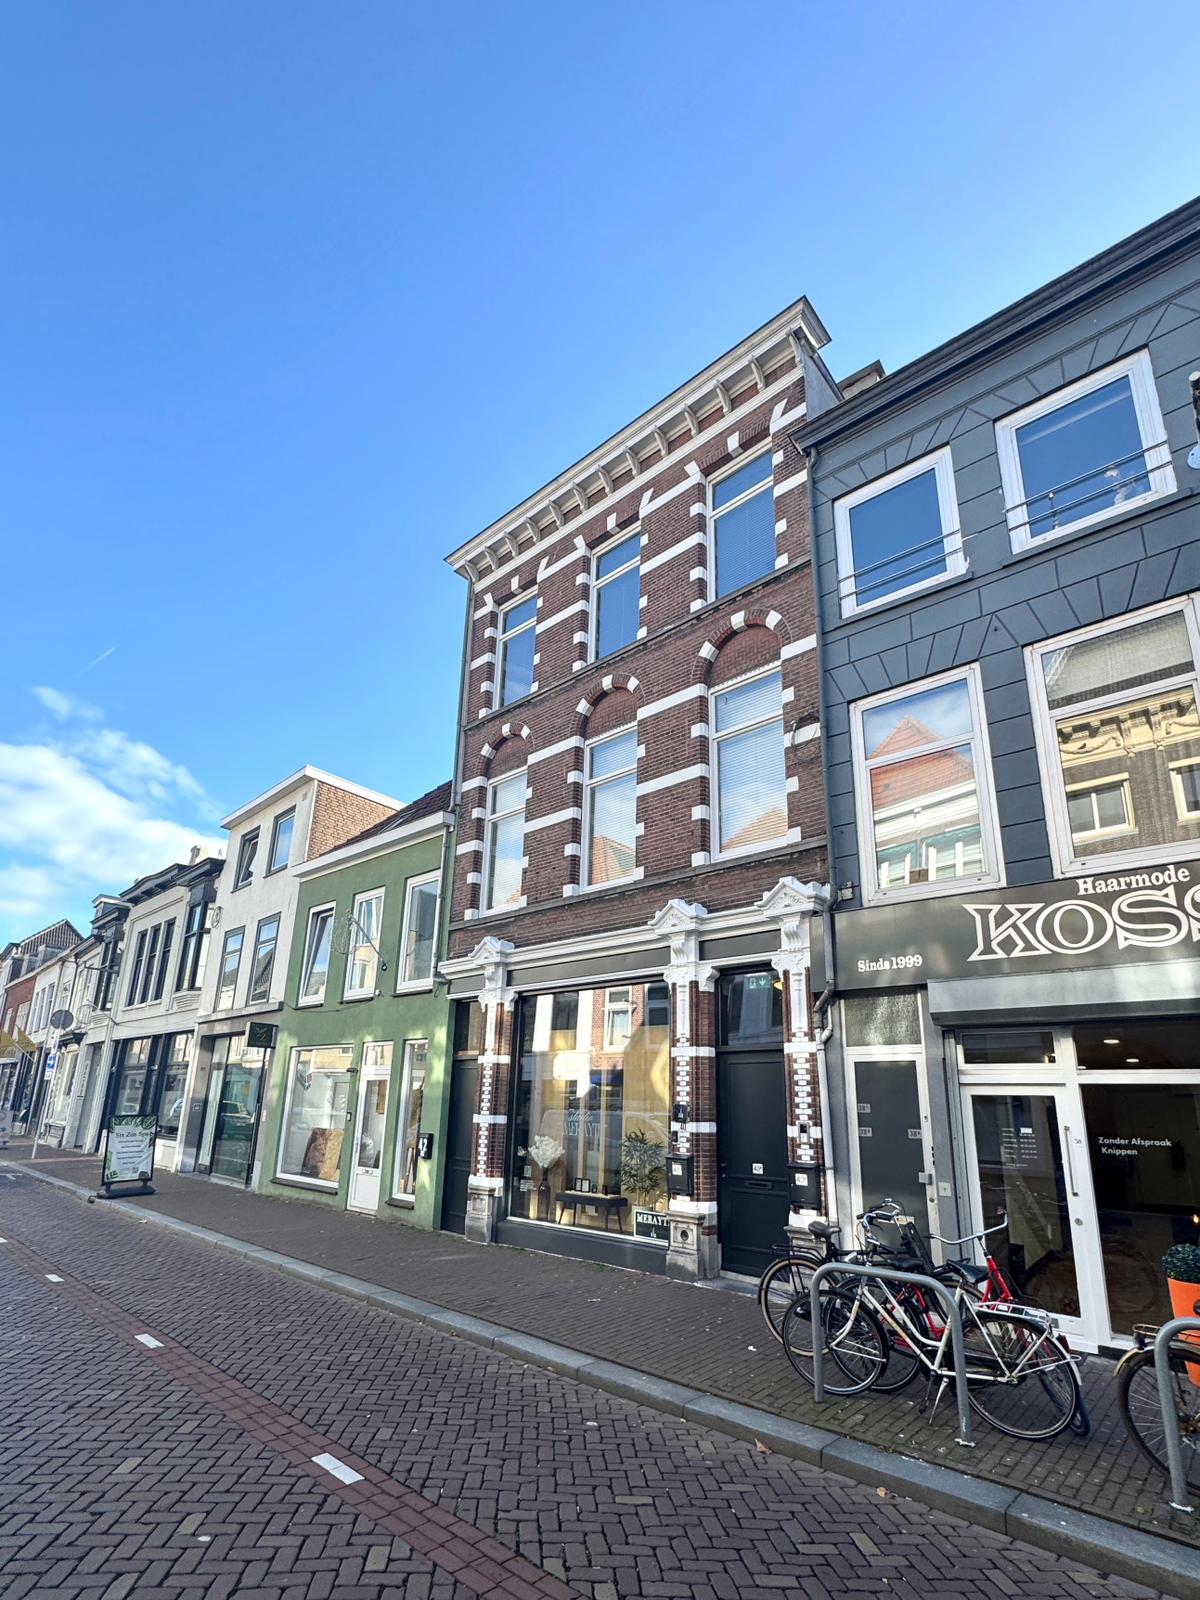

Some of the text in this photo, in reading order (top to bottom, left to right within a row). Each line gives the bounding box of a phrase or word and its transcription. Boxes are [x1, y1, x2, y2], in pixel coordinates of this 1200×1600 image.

[1076, 864, 1191, 896] Haarmode
[962, 883, 1200, 961] KOS
[857, 954, 923, 972] Sinds 1999
[418, 1137, 428, 1151] 42
[1098, 1136, 1172, 1147] Zonder Afspraak
[1101, 1147, 1138, 1156] Knippen
[636, 1213, 669, 1227] MERAYT
